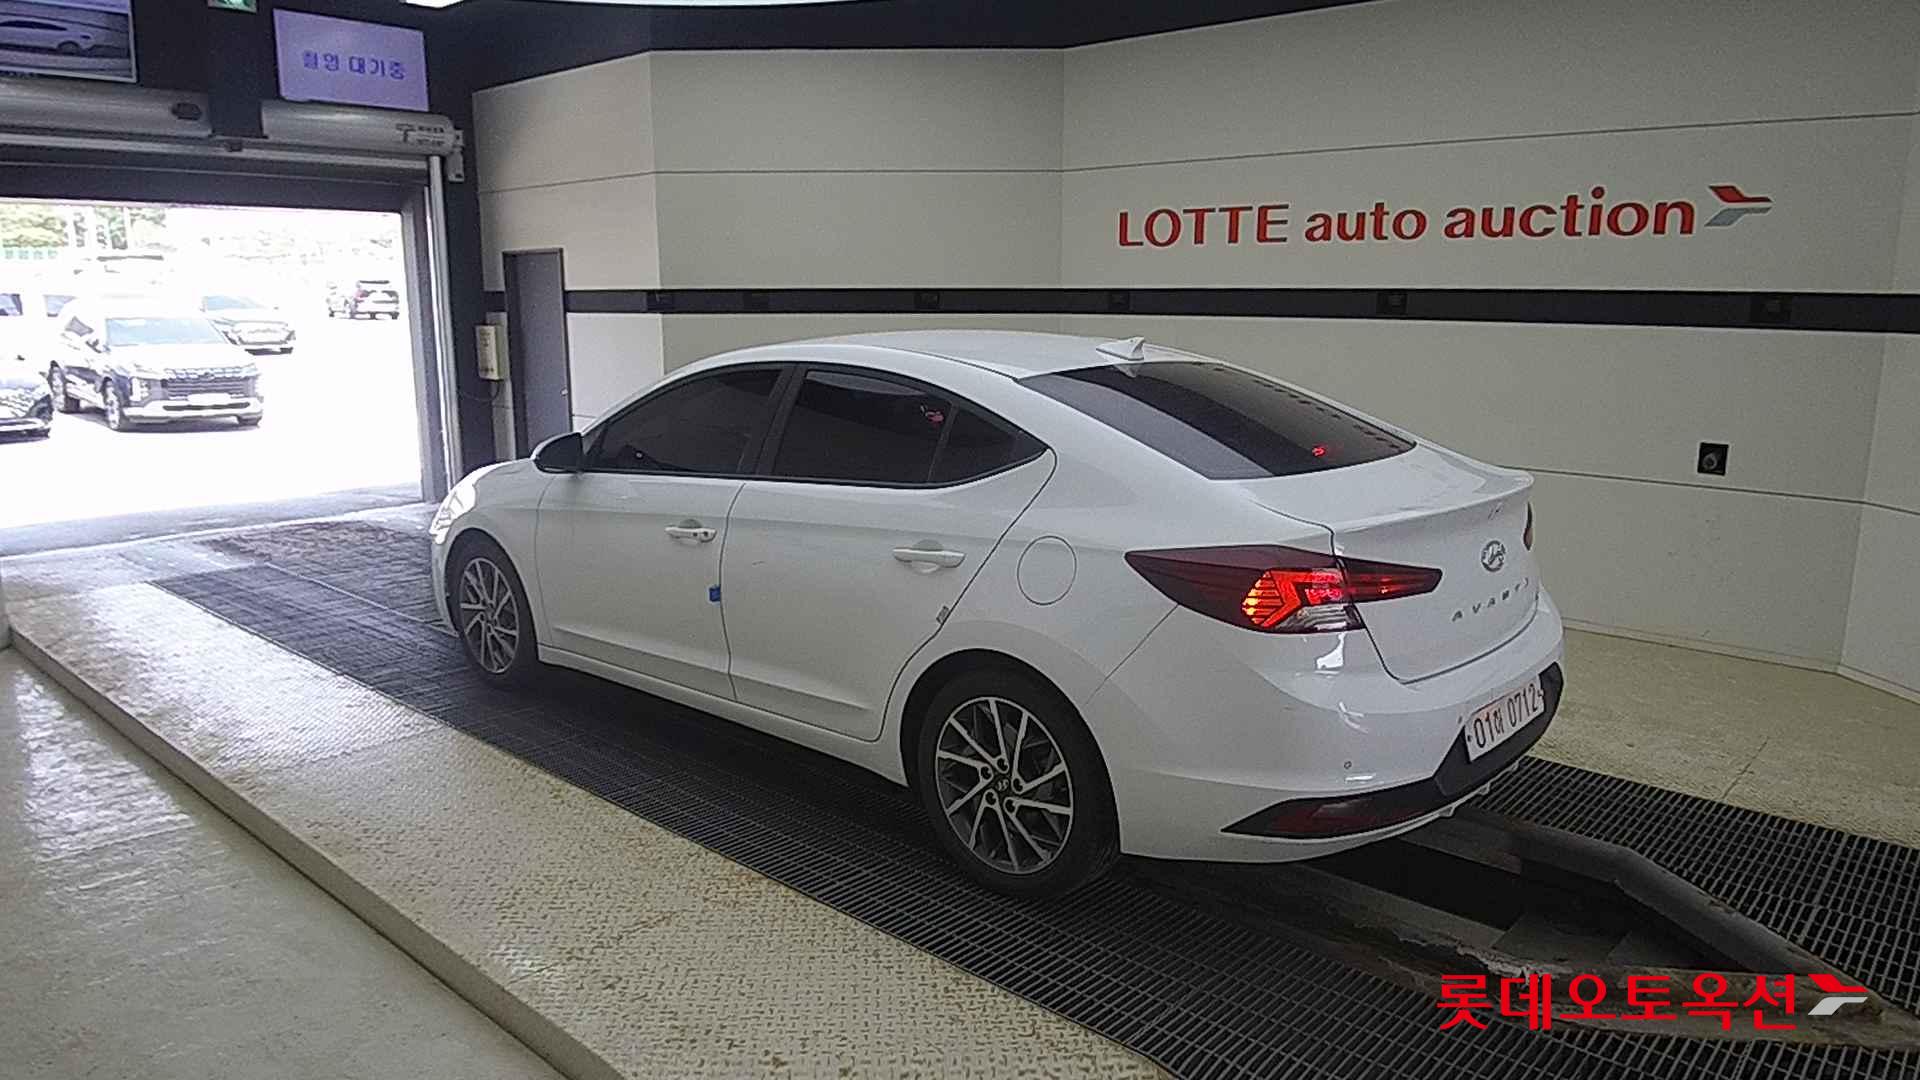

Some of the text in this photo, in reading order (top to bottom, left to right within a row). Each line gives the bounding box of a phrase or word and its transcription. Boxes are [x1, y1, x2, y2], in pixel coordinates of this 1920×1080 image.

[348, 56, 406, 80] 대기중
[1118, 186, 1695, 247] LOTTE auto auction
[1507, 683, 1539, 728] 0712
